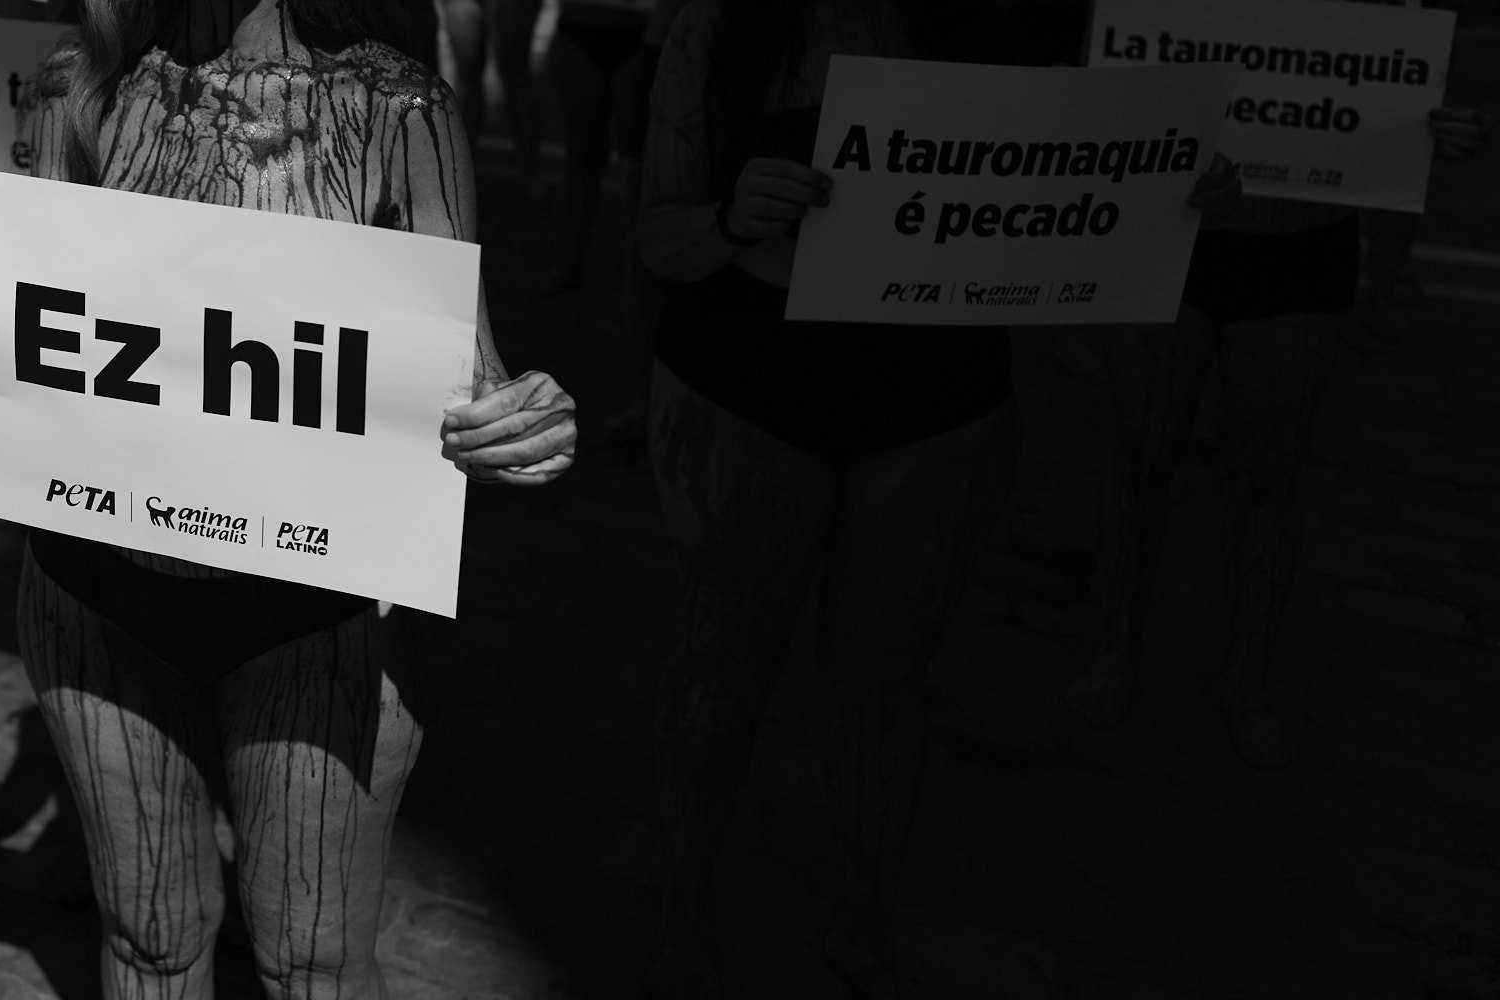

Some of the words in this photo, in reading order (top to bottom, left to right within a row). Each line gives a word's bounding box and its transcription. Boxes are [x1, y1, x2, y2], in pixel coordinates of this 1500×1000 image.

[1103, 25, 1147, 62] La
[1157, 30, 1430, 86] tauromaquia
[1225, 93, 1361, 134] ecado
[831, 125, 871, 172] A
[885, 127, 1201, 183] tauromaquia
[893, 191, 929, 235] é
[934, 192, 1120, 245] pecado
[15, 281, 161, 406] Ez
[202, 307, 369, 436] hil
[177, 505, 248, 531] anima
[177, 522, 247, 545] naturalis
